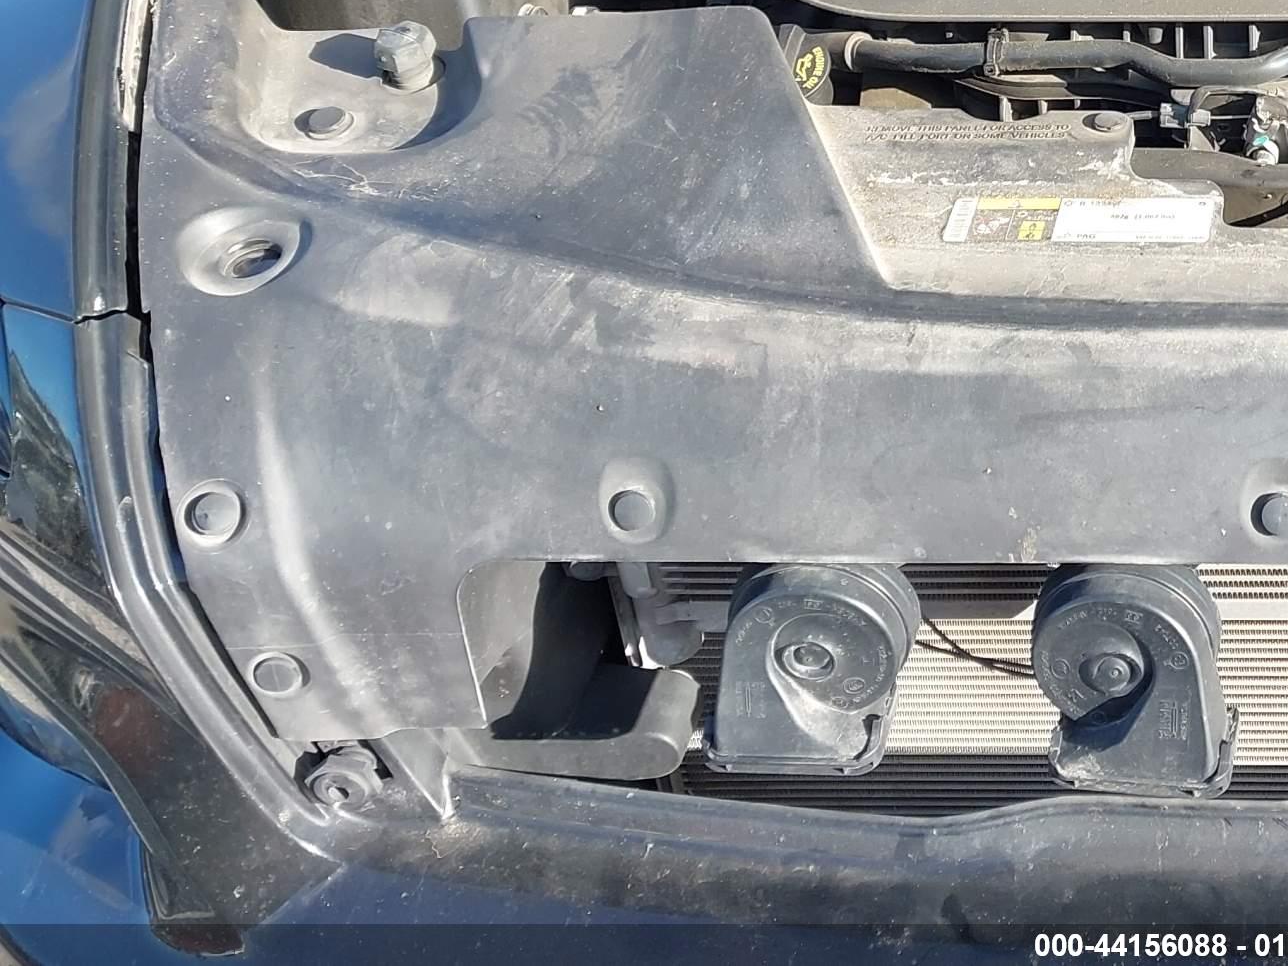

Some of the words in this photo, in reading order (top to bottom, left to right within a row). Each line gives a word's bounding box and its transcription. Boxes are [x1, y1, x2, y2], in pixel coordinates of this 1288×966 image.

[812, 46, 825, 75] ENGINE
[802, 76, 818, 89] OIL
[1008, 123, 1053, 132] ACCESS
[1054, 123, 1071, 132] TO
